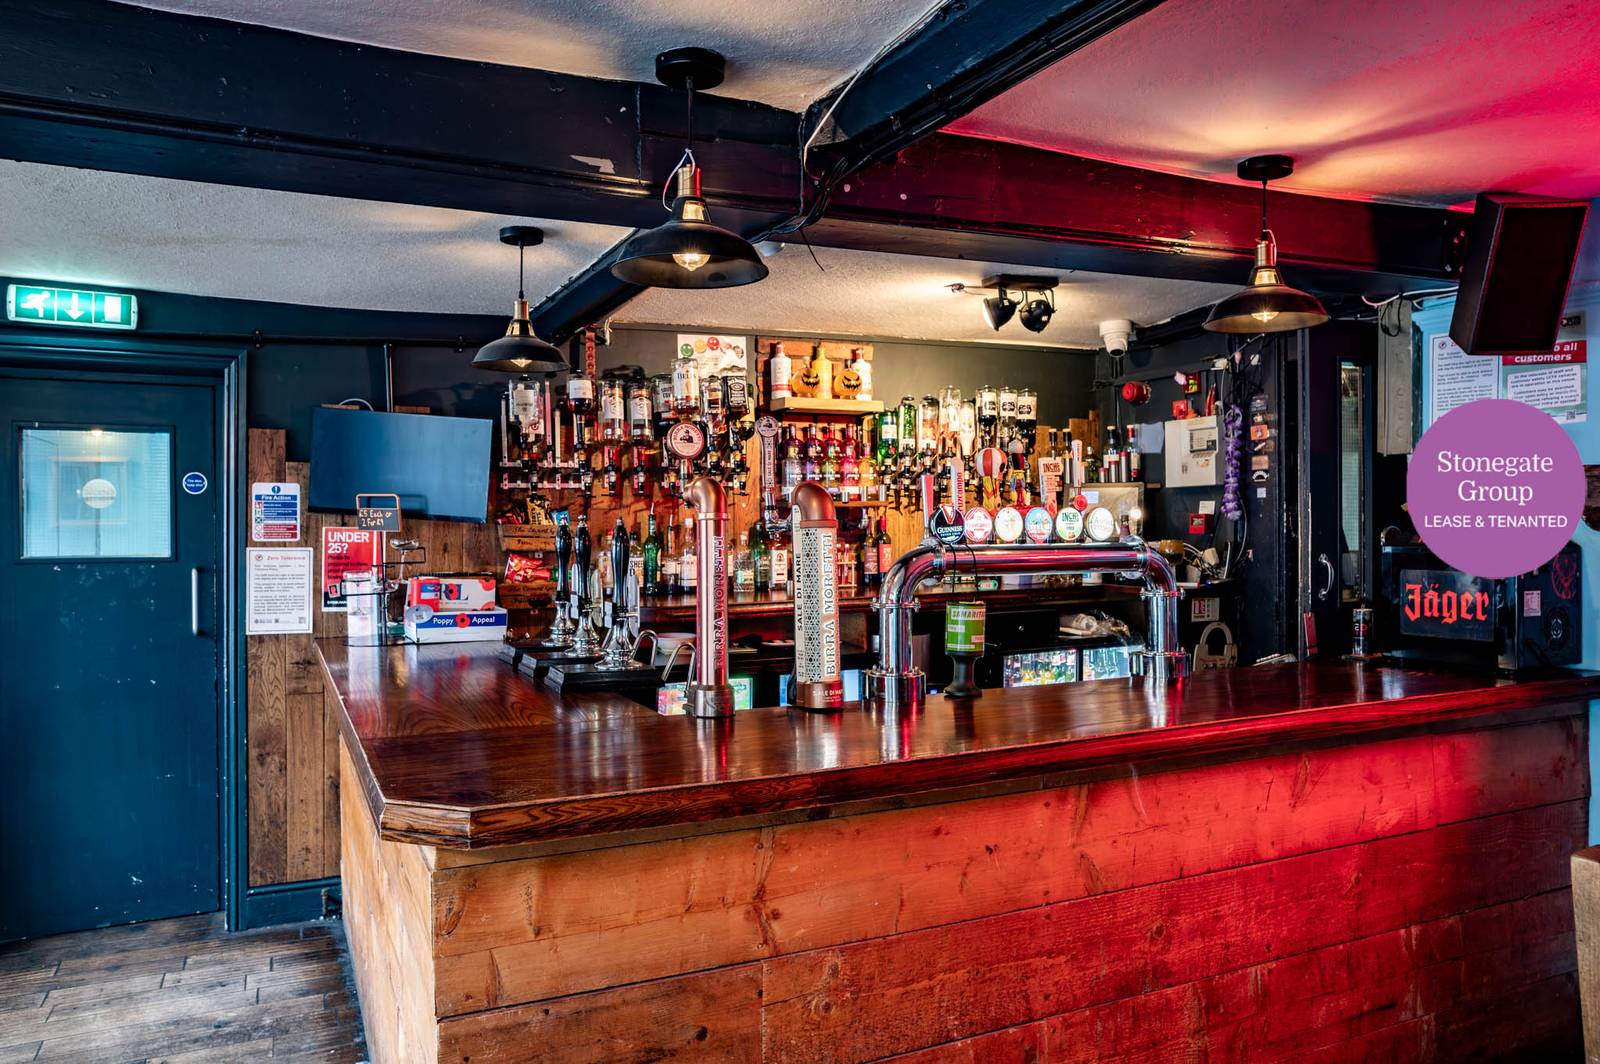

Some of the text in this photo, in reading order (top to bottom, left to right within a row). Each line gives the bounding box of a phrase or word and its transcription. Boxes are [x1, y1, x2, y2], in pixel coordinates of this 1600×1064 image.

[1563, 342, 1578, 351] all
[1514, 353, 1572, 363] customers
[937, 525, 963, 534] GUINNESS
[328, 531, 369, 543] UNDER
[328, 543, 348, 553] 25?
[796, 586, 802, 599] DI
[823, 534, 836, 676] BIRRA MORETTI
[1404, 583, 1489, 624] Jäger
[432, 617, 454, 625] Poppy
